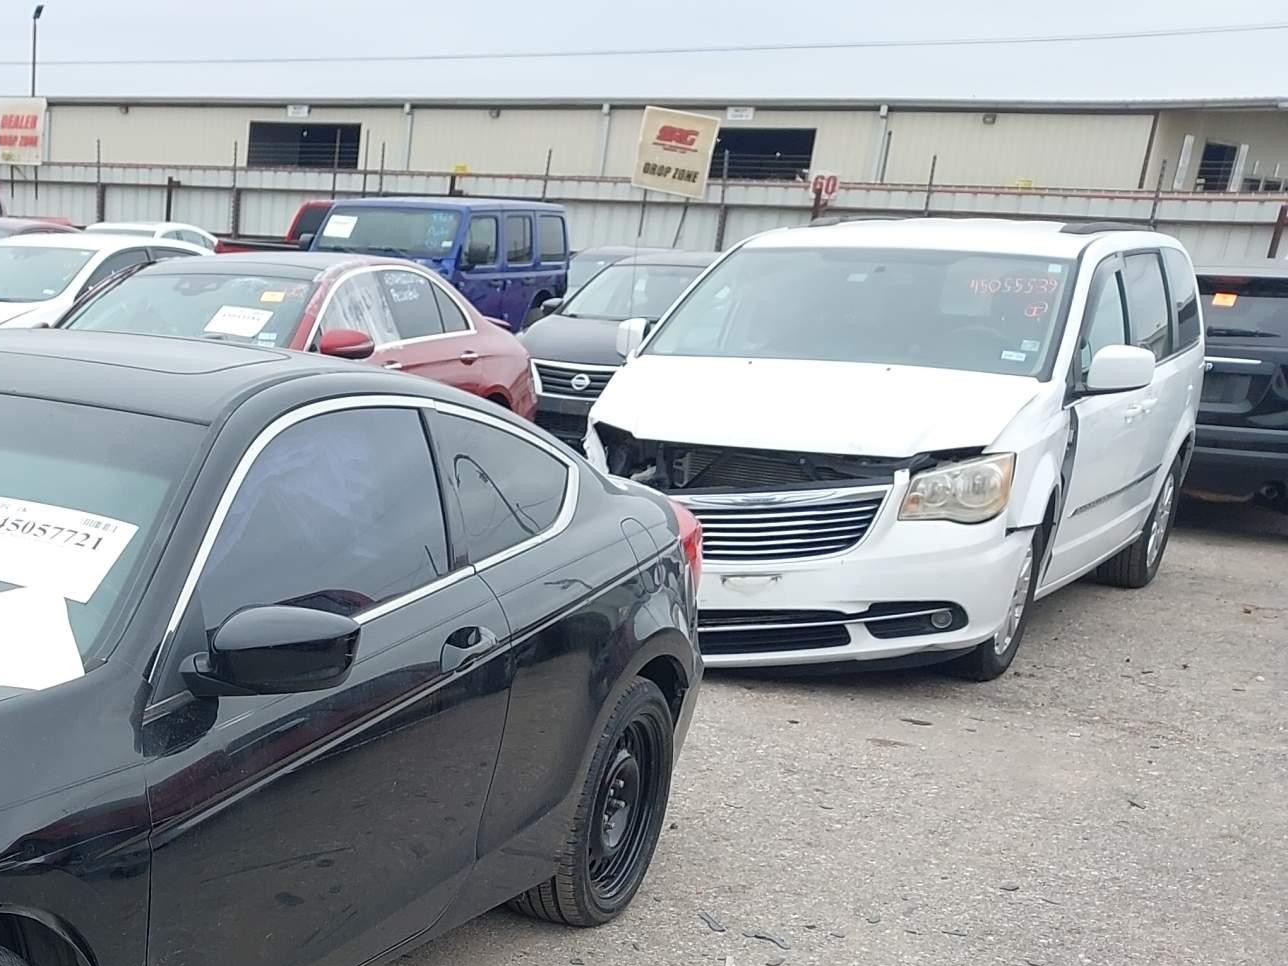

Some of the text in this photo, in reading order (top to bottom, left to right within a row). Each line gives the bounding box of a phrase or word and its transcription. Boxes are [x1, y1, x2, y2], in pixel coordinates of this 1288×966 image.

[0, 114, 39, 129] DEALER
[642, 161, 700, 184] DROP ZONE
